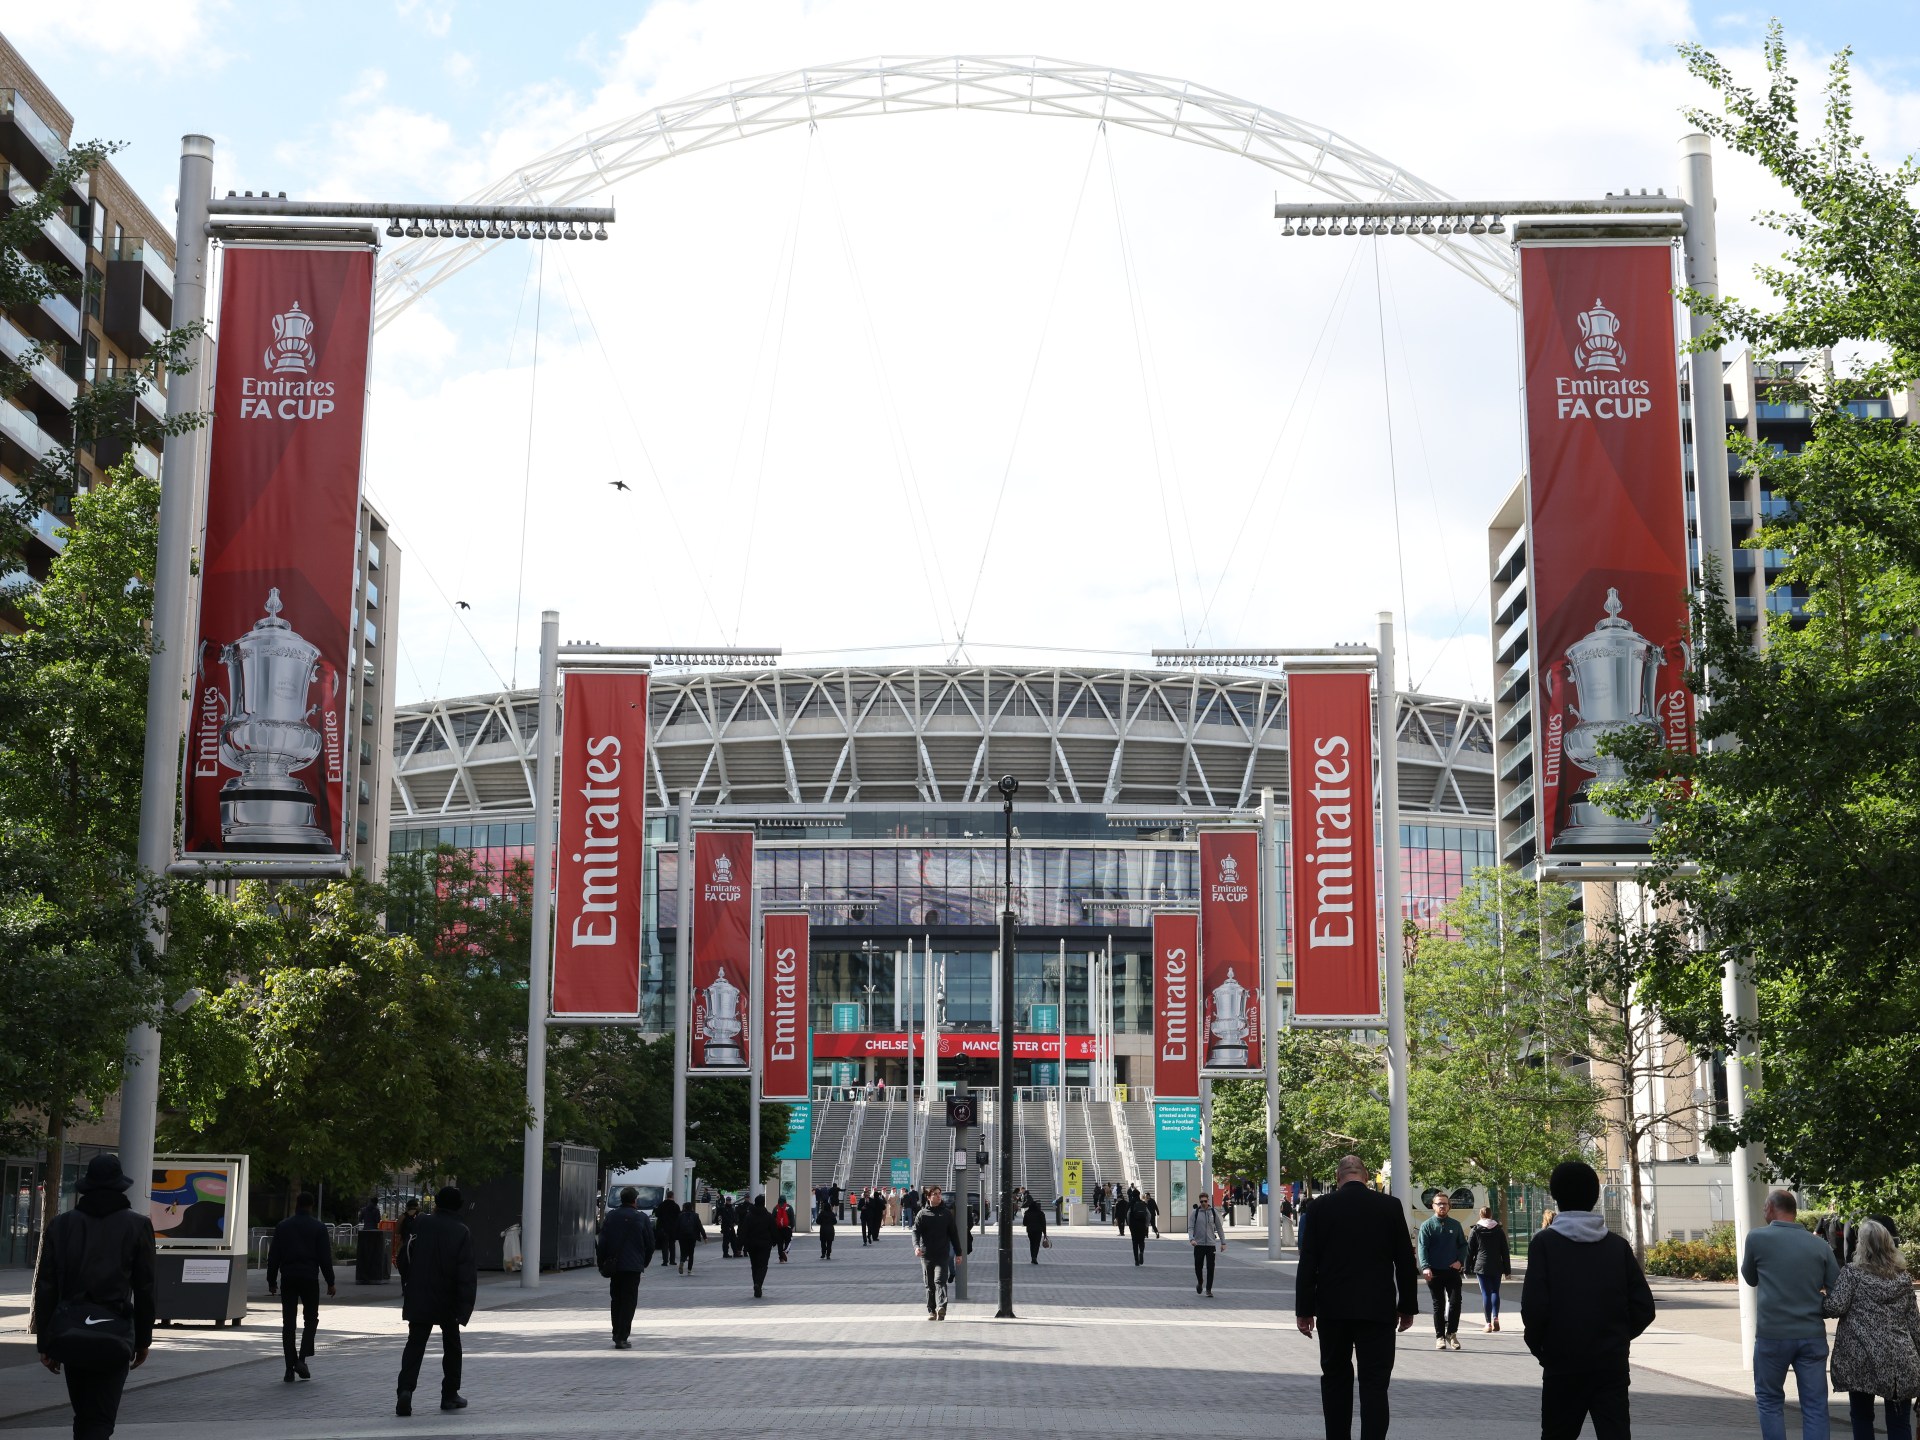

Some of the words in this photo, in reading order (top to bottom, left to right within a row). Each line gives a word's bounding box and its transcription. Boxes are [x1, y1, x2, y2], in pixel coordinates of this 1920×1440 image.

[242, 377, 335, 397] Emirates
[1555, 375, 1650, 396] Emirates
[240, 398, 273, 419] FA
[277, 398, 335, 420] CUP
[1557, 397, 1592, 419] FA
[1595, 397, 1652, 420] CUP
[195, 686, 219, 778] Emirates
[324, 710, 342, 783] Emirates
[1666, 690, 1689, 782] irates
[1543, 713, 1563, 788] Emirates
[572, 735, 622, 949] Emirates
[1305, 735, 1354, 950] Emirates
[704, 892, 717, 901] FA
[719, 892, 741, 902] CUP
[705, 883, 741, 892] Emirates
[1211, 884, 1248, 893] Emirates
[1212, 893, 1225, 902] FA
[1226, 893, 1248, 902] CUP
[770, 947, 796, 1062] Emirates
[1161, 948, 1187, 1062] Emirates
[694, 1005, 704, 1041] Emirates
[1249, 1006, 1258, 1043] Emirates
[962, 1041, 1039, 1051] MANCSTER
